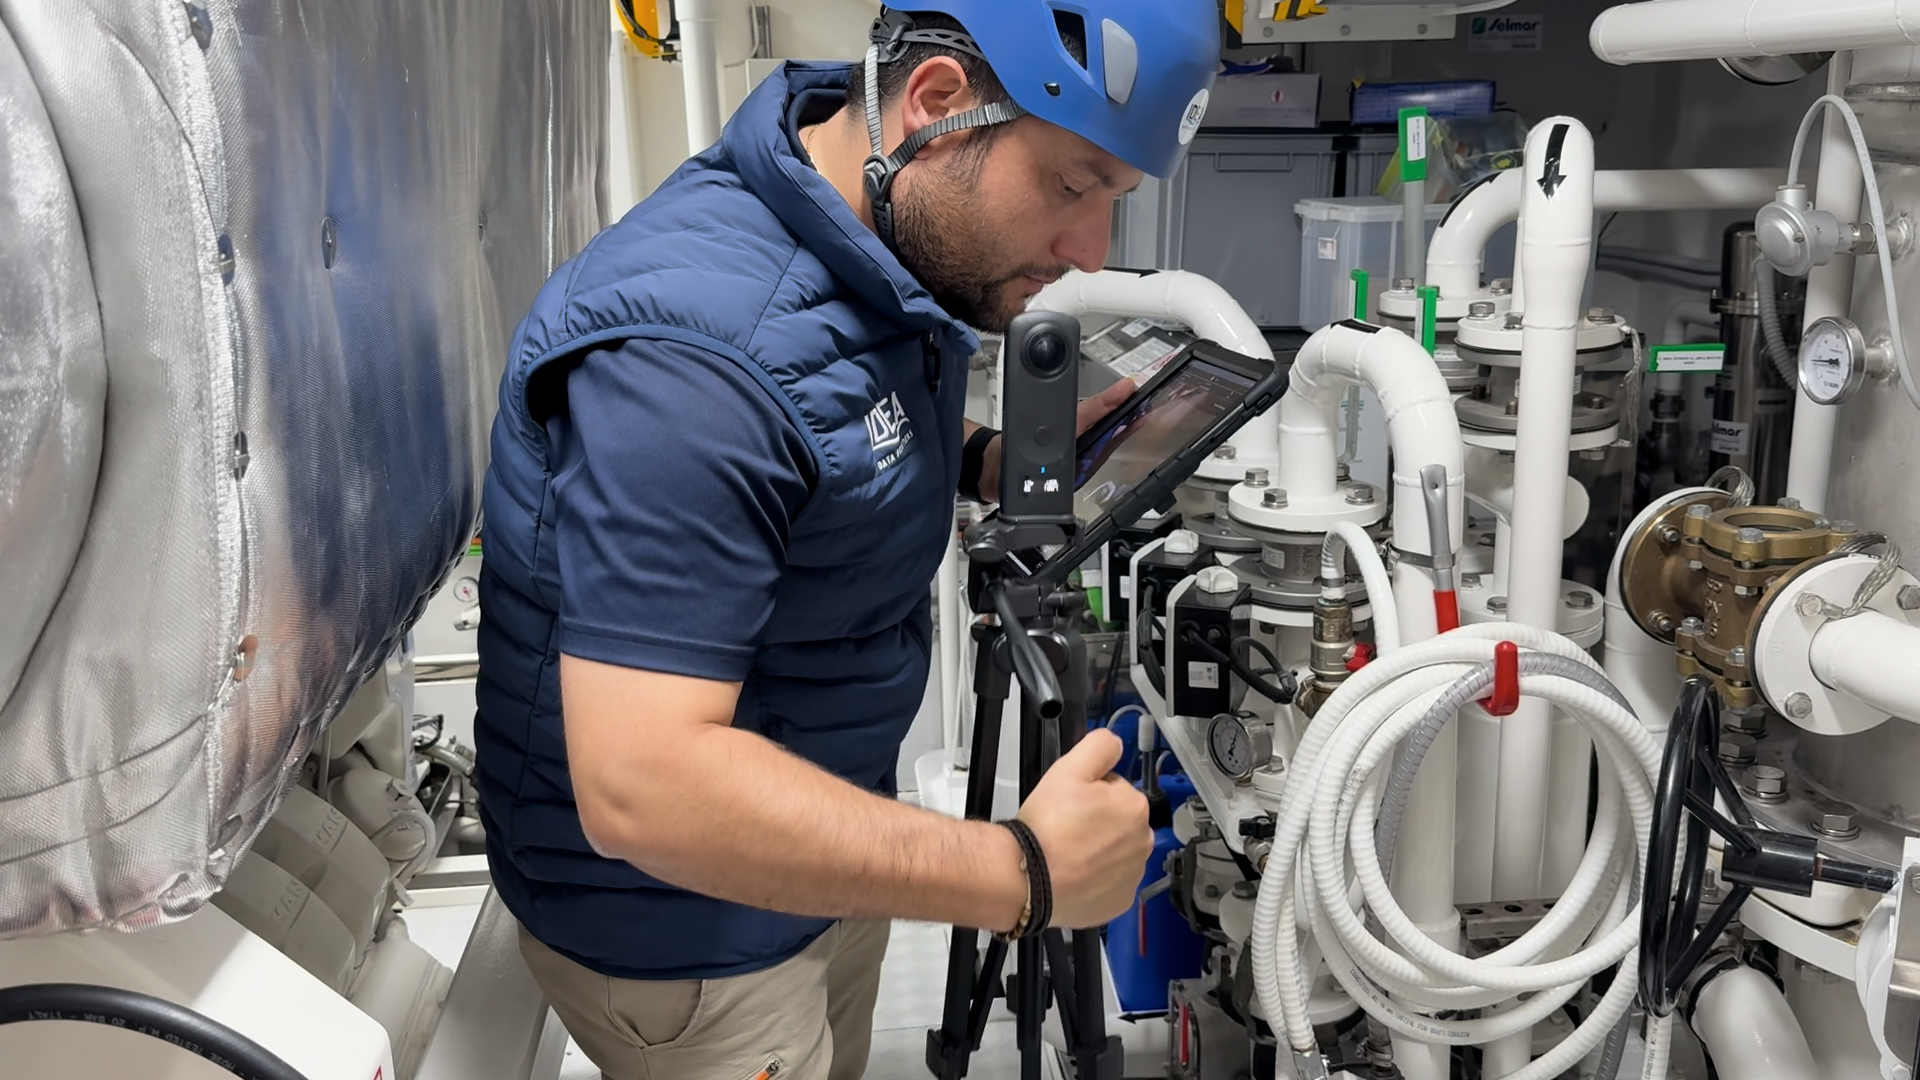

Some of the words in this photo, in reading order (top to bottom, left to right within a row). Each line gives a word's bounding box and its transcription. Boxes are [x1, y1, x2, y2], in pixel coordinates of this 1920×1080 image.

[864, 391, 905, 449] IDEA
[877, 453, 896, 471] DATA
[165, 1033, 204, 1056] TESTED
[210, 1052, 236, 1071] HOSE
